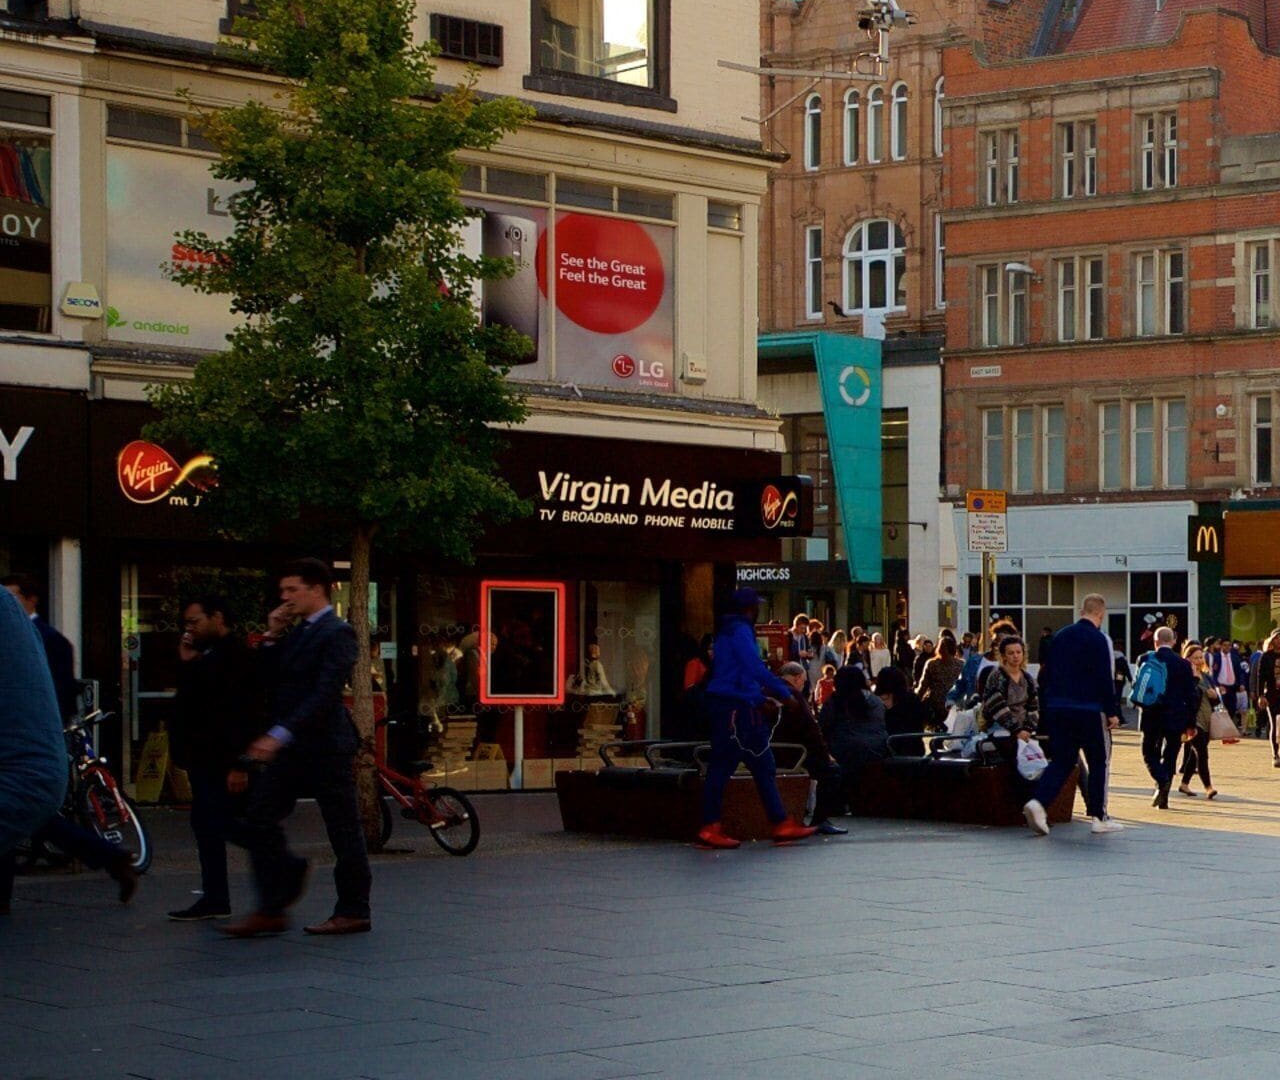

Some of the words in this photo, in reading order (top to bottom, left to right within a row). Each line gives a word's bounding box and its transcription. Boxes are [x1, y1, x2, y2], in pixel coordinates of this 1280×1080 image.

[560, 253, 584, 267] See
[587, 257, 608, 270] the
[610, 260, 646, 275] Great
[560, 268, 585, 283] Feel
[588, 272, 609, 286] the
[611, 276, 647, 291] Great
[133, 321, 190, 335] android
[639, 360, 665, 378] LG
[124, 452, 173, 492] Virgin
[538, 471, 630, 510] Virgin
[640, 478, 735, 511] Media
[539, 509, 556, 521] TV
[562, 511, 638, 525] BROADBAND
[644, 515, 685, 528] PHONE
[691, 518, 735, 530] MOBILE
[737, 568, 790, 581] HIGHCROSS
